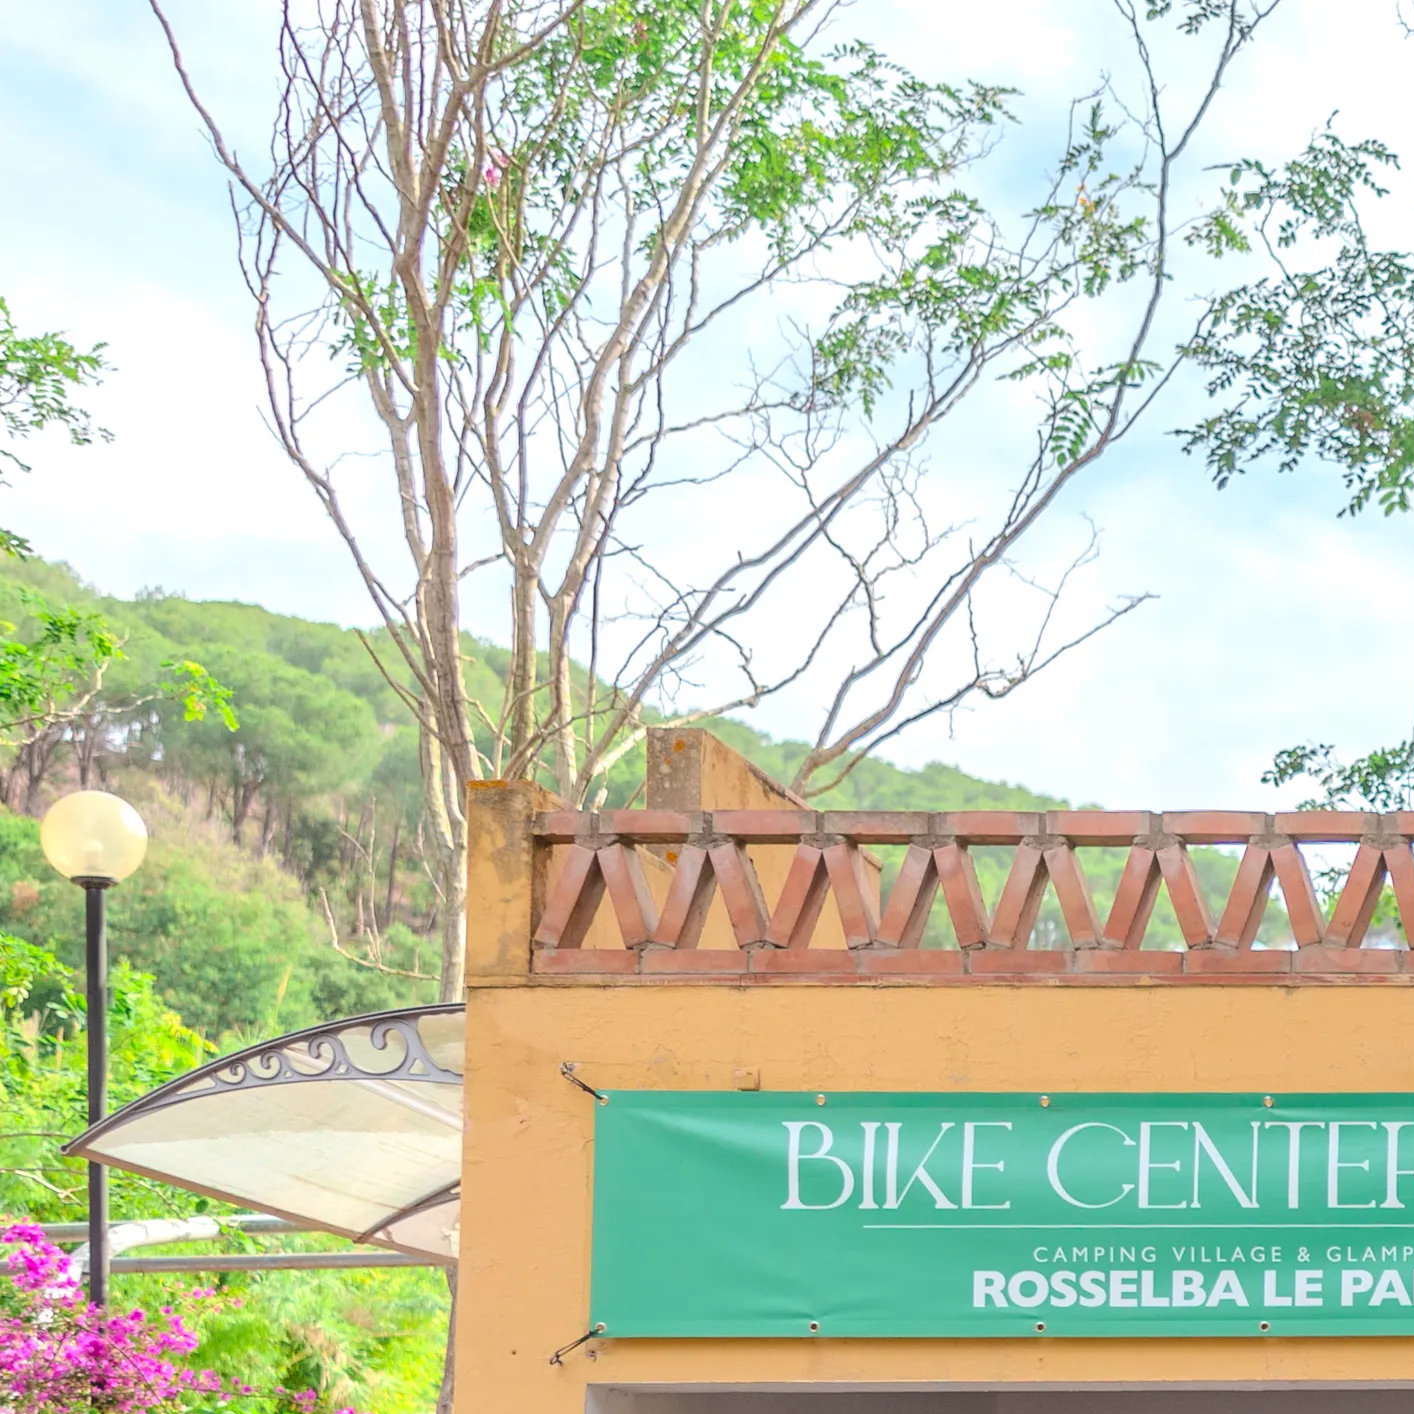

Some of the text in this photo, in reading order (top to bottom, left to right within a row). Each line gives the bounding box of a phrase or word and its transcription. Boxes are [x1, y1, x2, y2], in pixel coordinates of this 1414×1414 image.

[780, 1120, 1013, 1210] BIKE
[1033, 1246, 1157, 1263] CAMPING
[1172, 1246, 1282, 1263] VILLAGE
[1297, 1246, 1311, 1263] &
[972, 1269, 1249, 1308] ROSSELBA
[1263, 1269, 1324, 1308] LE
